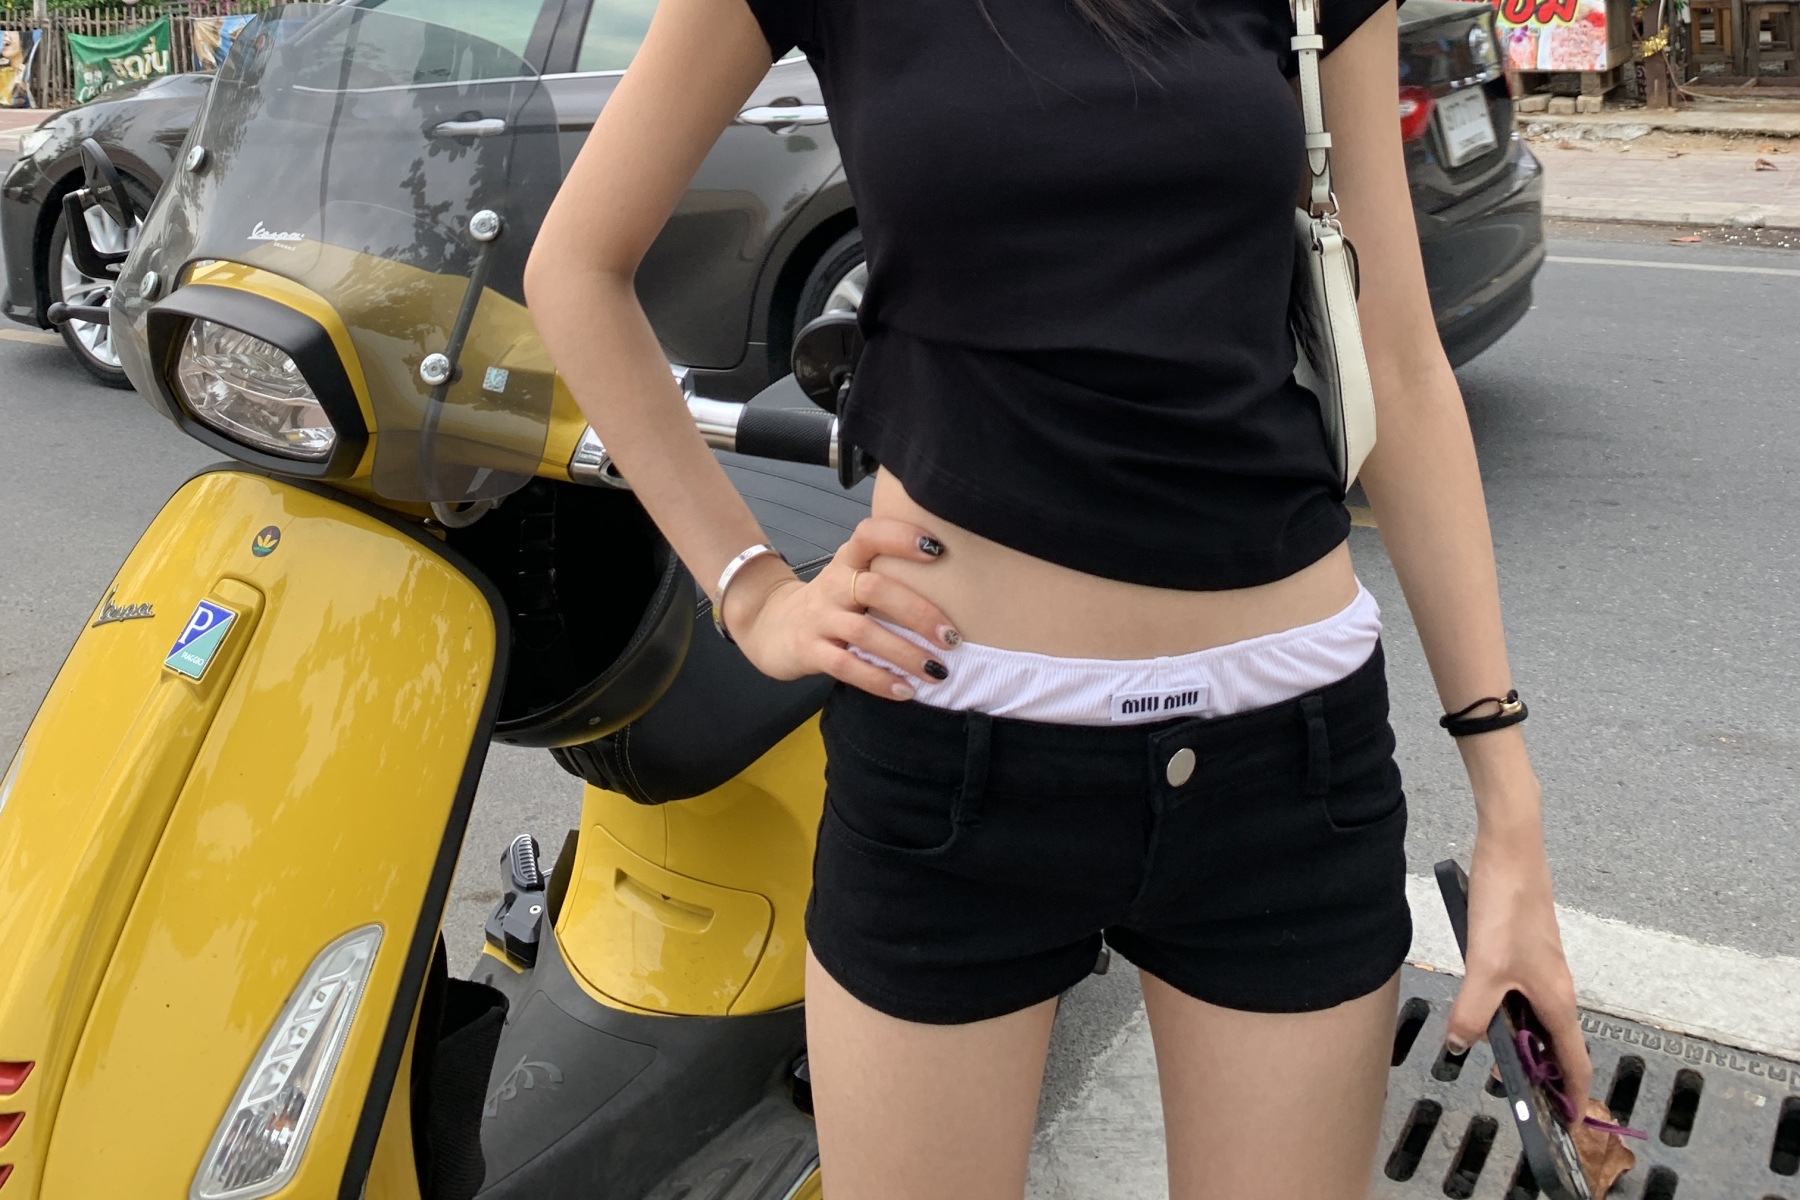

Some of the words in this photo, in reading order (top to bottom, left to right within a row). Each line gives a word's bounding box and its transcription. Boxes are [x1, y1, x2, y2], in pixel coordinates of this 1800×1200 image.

[92, 583, 155, 628] Vespa
[178, 607, 213, 644] P
[181, 651, 204, 666] PIAGGIO
